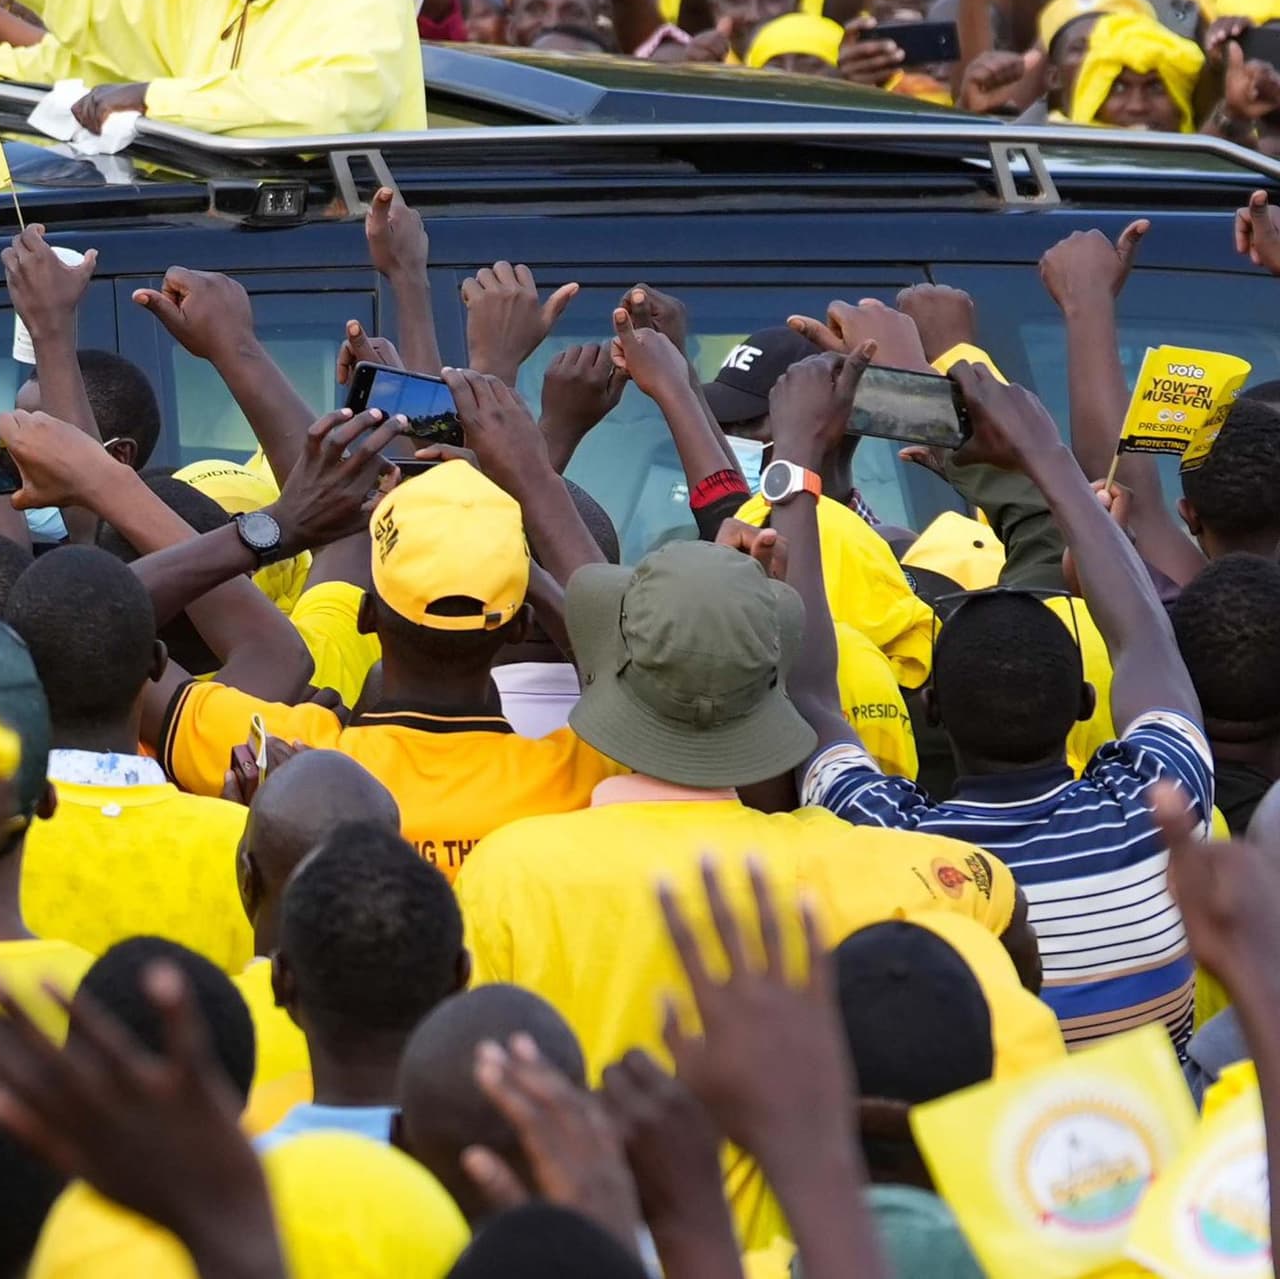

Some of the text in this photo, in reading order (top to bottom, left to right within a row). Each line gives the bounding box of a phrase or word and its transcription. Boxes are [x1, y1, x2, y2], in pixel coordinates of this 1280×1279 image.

[721, 344, 763, 371] KE
[1167, 363, 1205, 379] vote
[1152, 378, 1213, 399] YOWERI
[1142, 390, 1214, 410] MUSEVEN
[1134, 438, 1187, 450] PROTECTING
[188, 469, 252, 484] ESIDEN
[443, 839, 481, 868] TH
